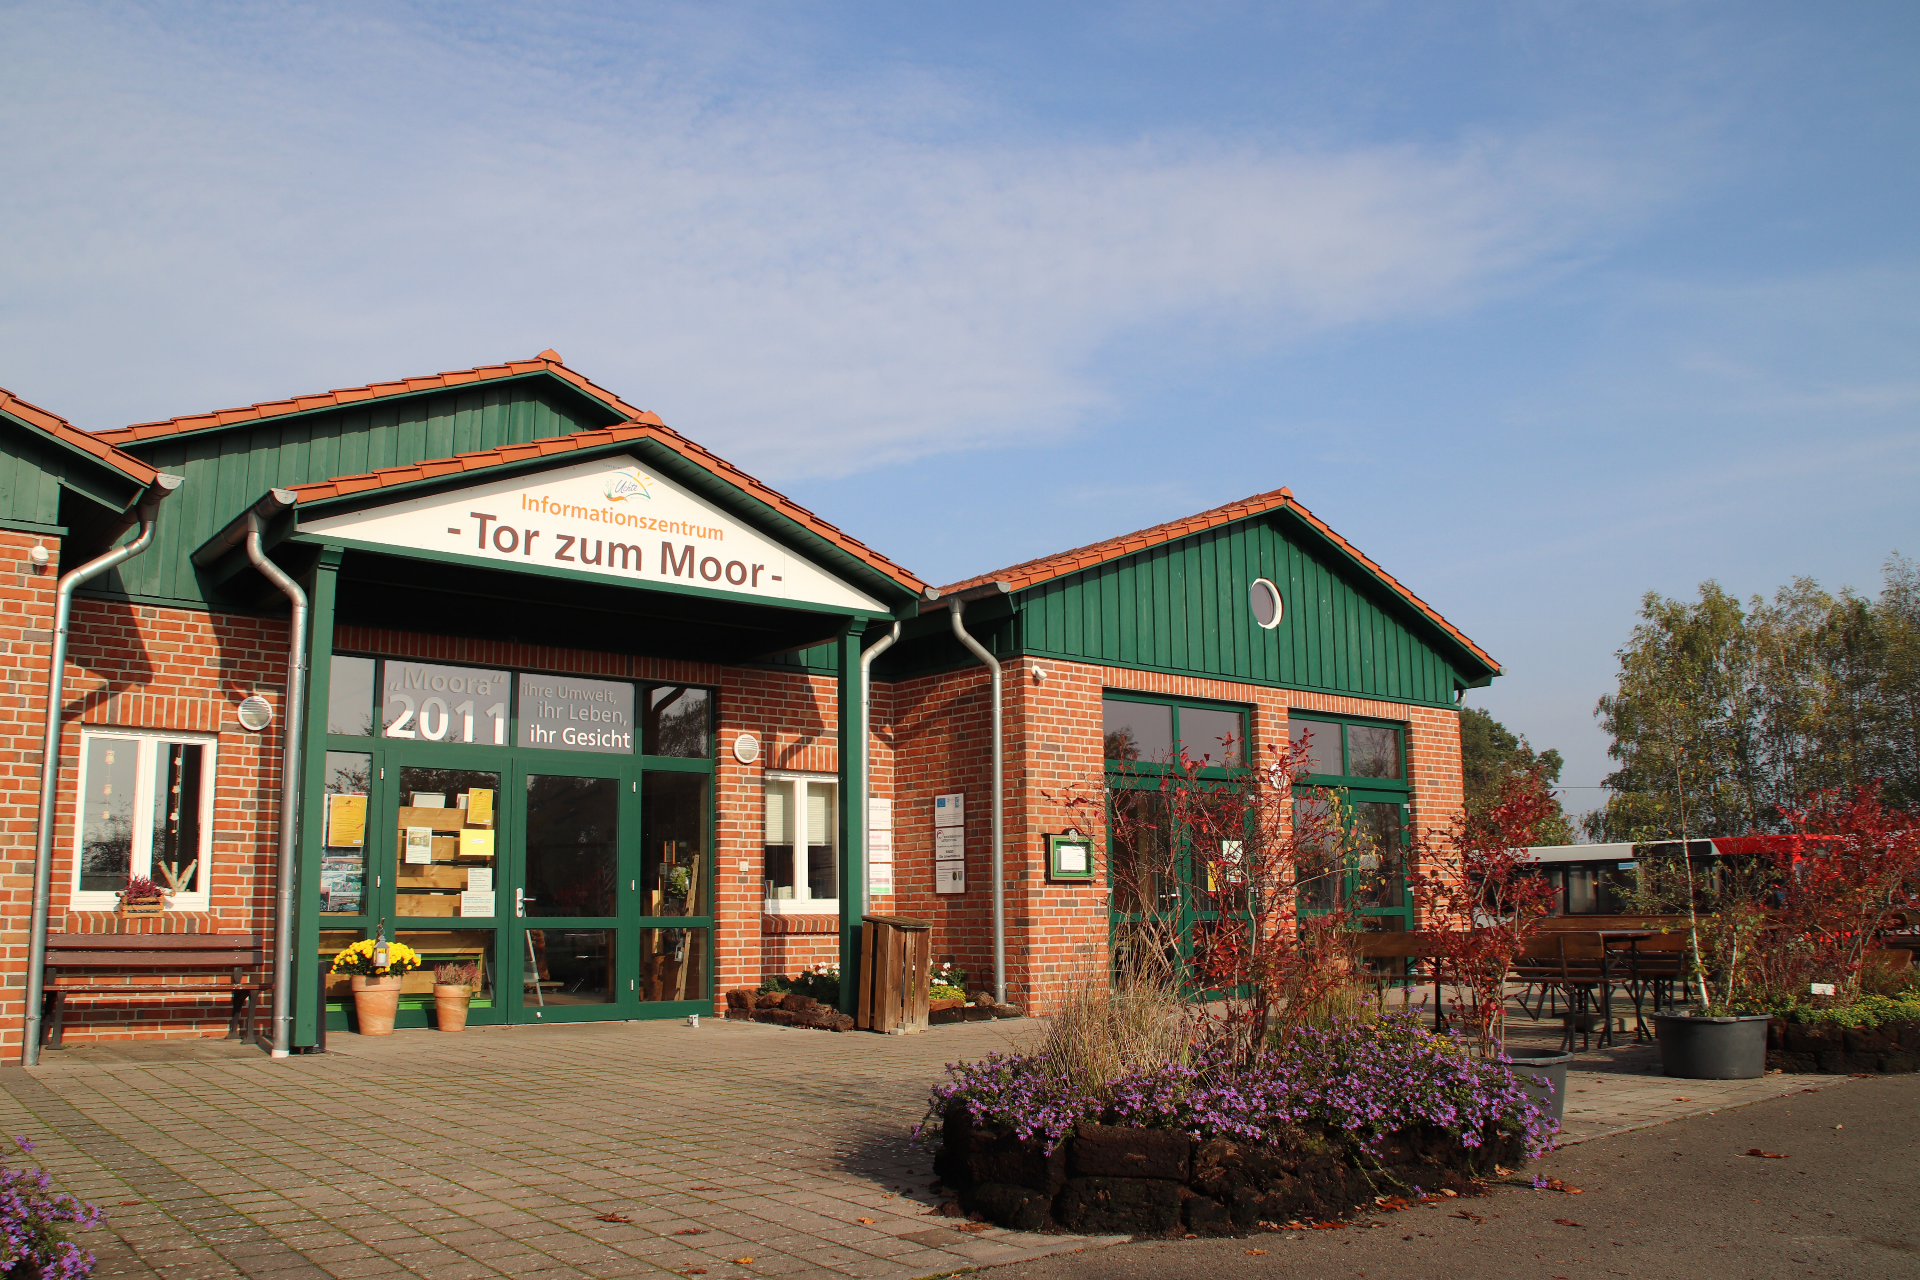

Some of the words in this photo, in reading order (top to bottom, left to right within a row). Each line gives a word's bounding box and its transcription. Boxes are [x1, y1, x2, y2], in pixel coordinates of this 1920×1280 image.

[614, 479, 639, 494] Uchte
[521, 493, 724, 541] Informationszentrum
[554, 533, 643, 571] zum
[523, 682, 553, 699] ihre
[557, 686, 618, 705] Umwelt,
[386, 694, 505, 745] 2011
[537, 701, 563, 719] ihr
[568, 704, 628, 726] Leben,
[529, 725, 556, 744] ihr
[562, 727, 631, 749] Gesicht
